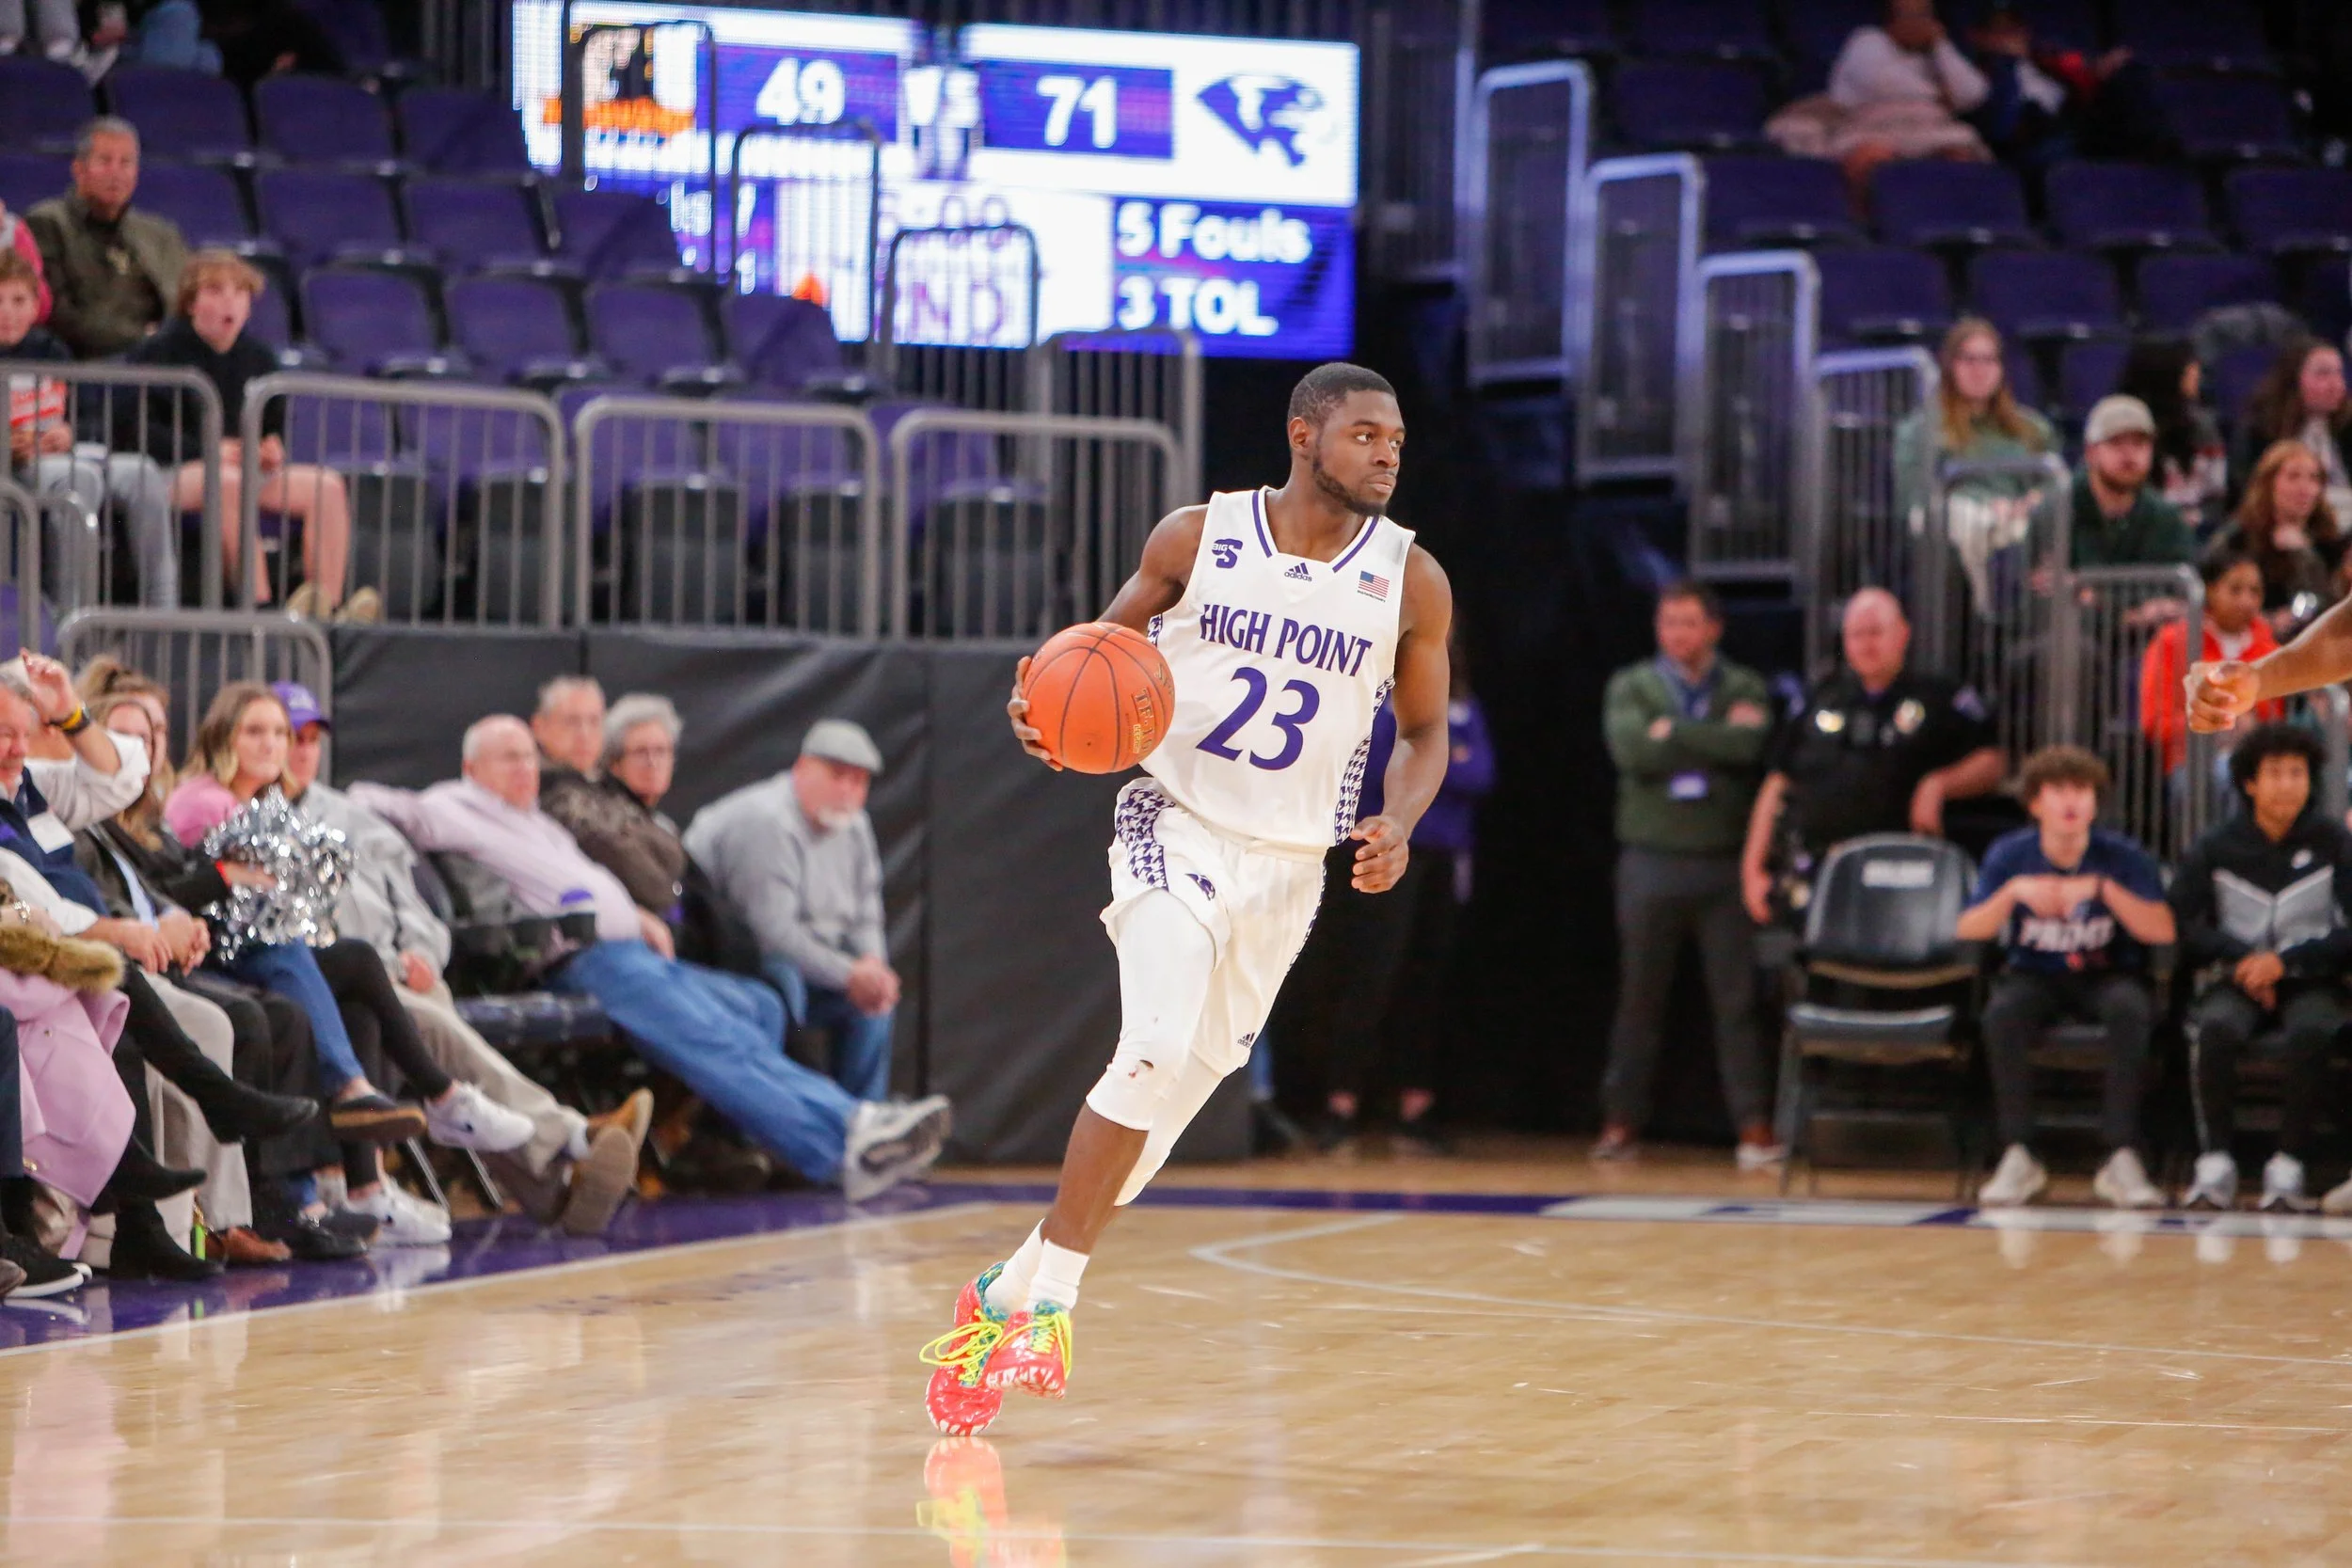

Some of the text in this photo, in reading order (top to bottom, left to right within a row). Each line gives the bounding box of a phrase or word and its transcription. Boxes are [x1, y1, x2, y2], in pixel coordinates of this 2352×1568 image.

[755, 57, 846, 125] 49
[1036, 74, 1118, 148] 71
[1117, 201, 1313, 264] 5 Fouls
[1117, 276, 1280, 337] 3 TOL
[1283, 571, 1312, 582] adidas
[1200, 604, 1374, 677] HIGH POINT
[1195, 666, 1321, 771] 23
